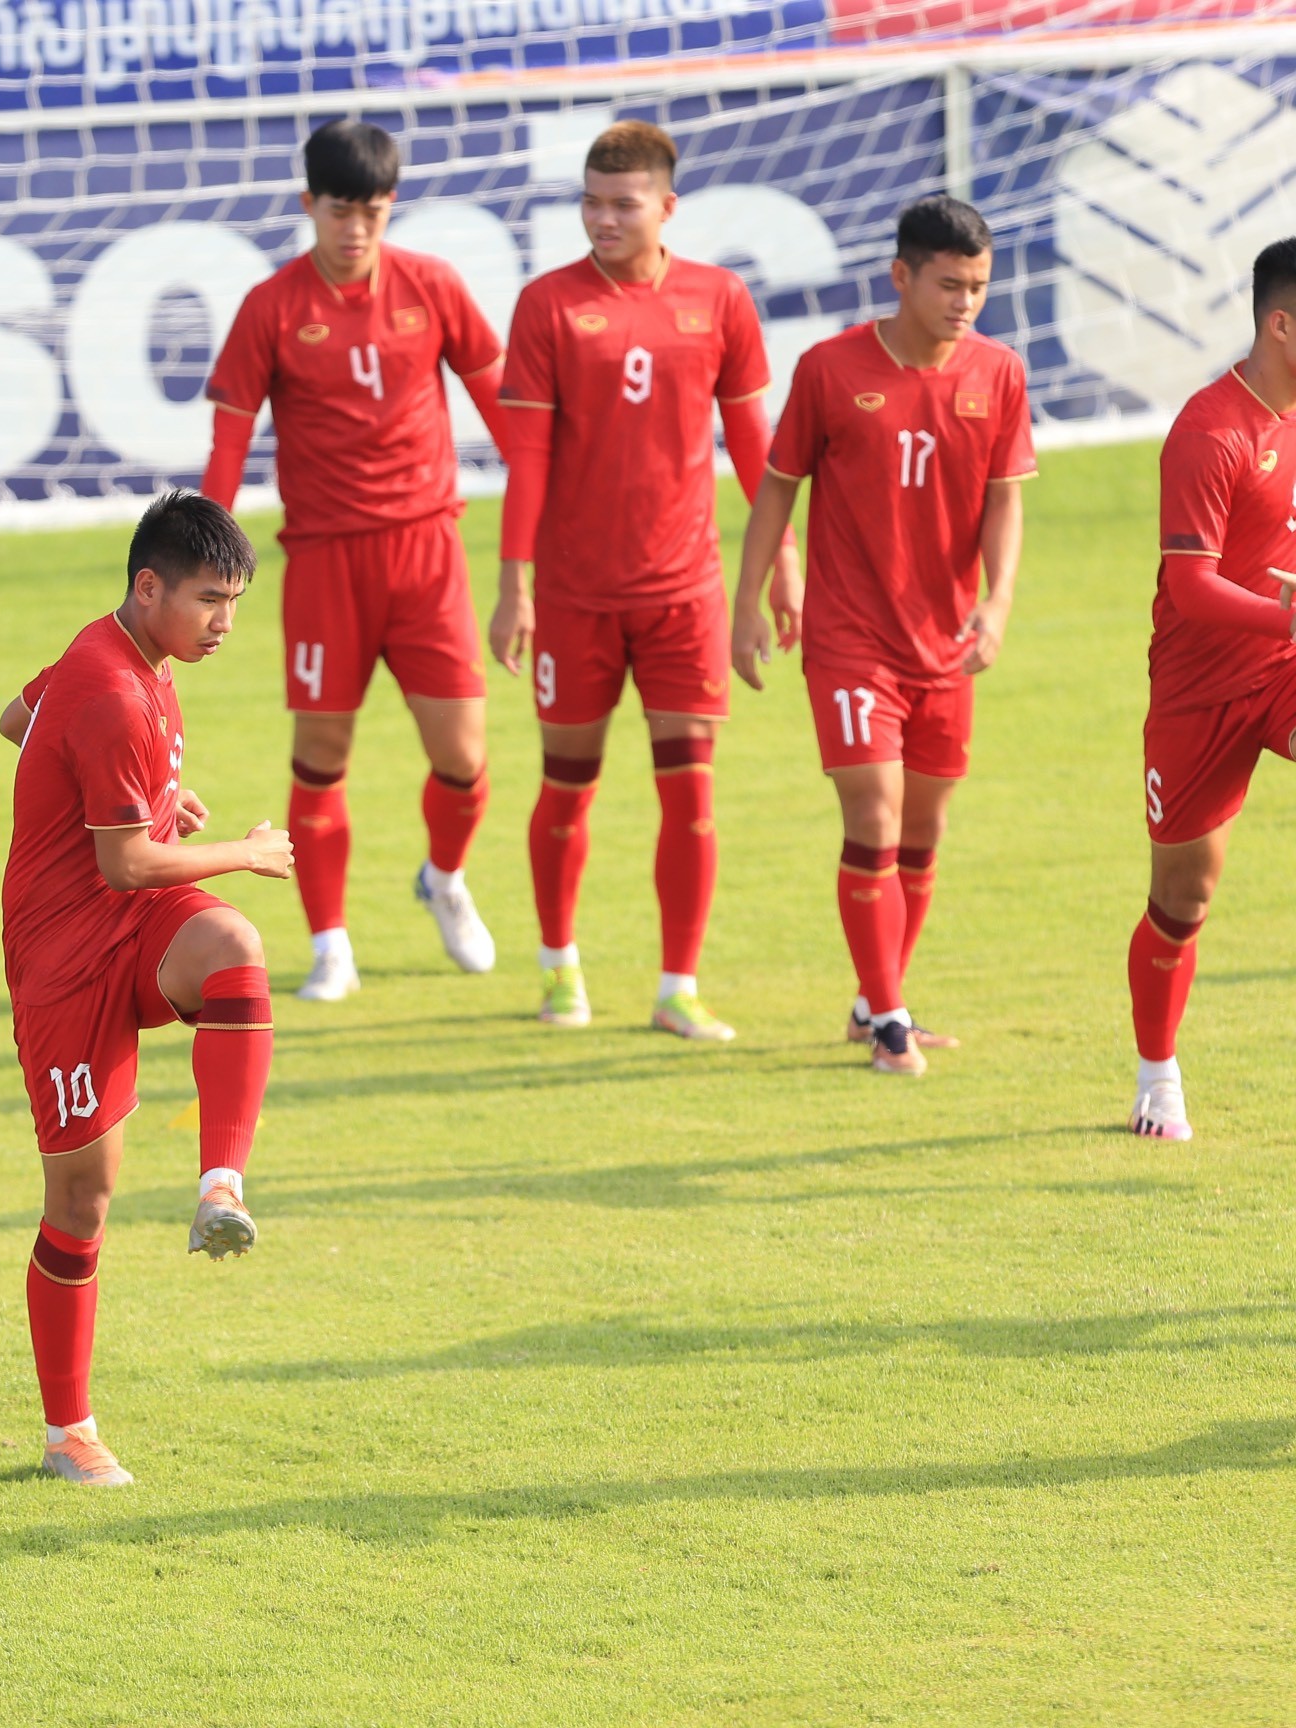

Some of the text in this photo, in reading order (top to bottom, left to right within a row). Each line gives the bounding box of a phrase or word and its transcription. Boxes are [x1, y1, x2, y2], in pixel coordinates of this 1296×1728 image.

[349, 343, 384, 400] 4
[622, 344, 654, 404] 9
[897, 429, 936, 488] 17
[294, 643, 323, 699] 4
[537, 652, 555, 707] 9
[833, 686, 880, 746] 17
[49, 1061, 100, 1128] 10
